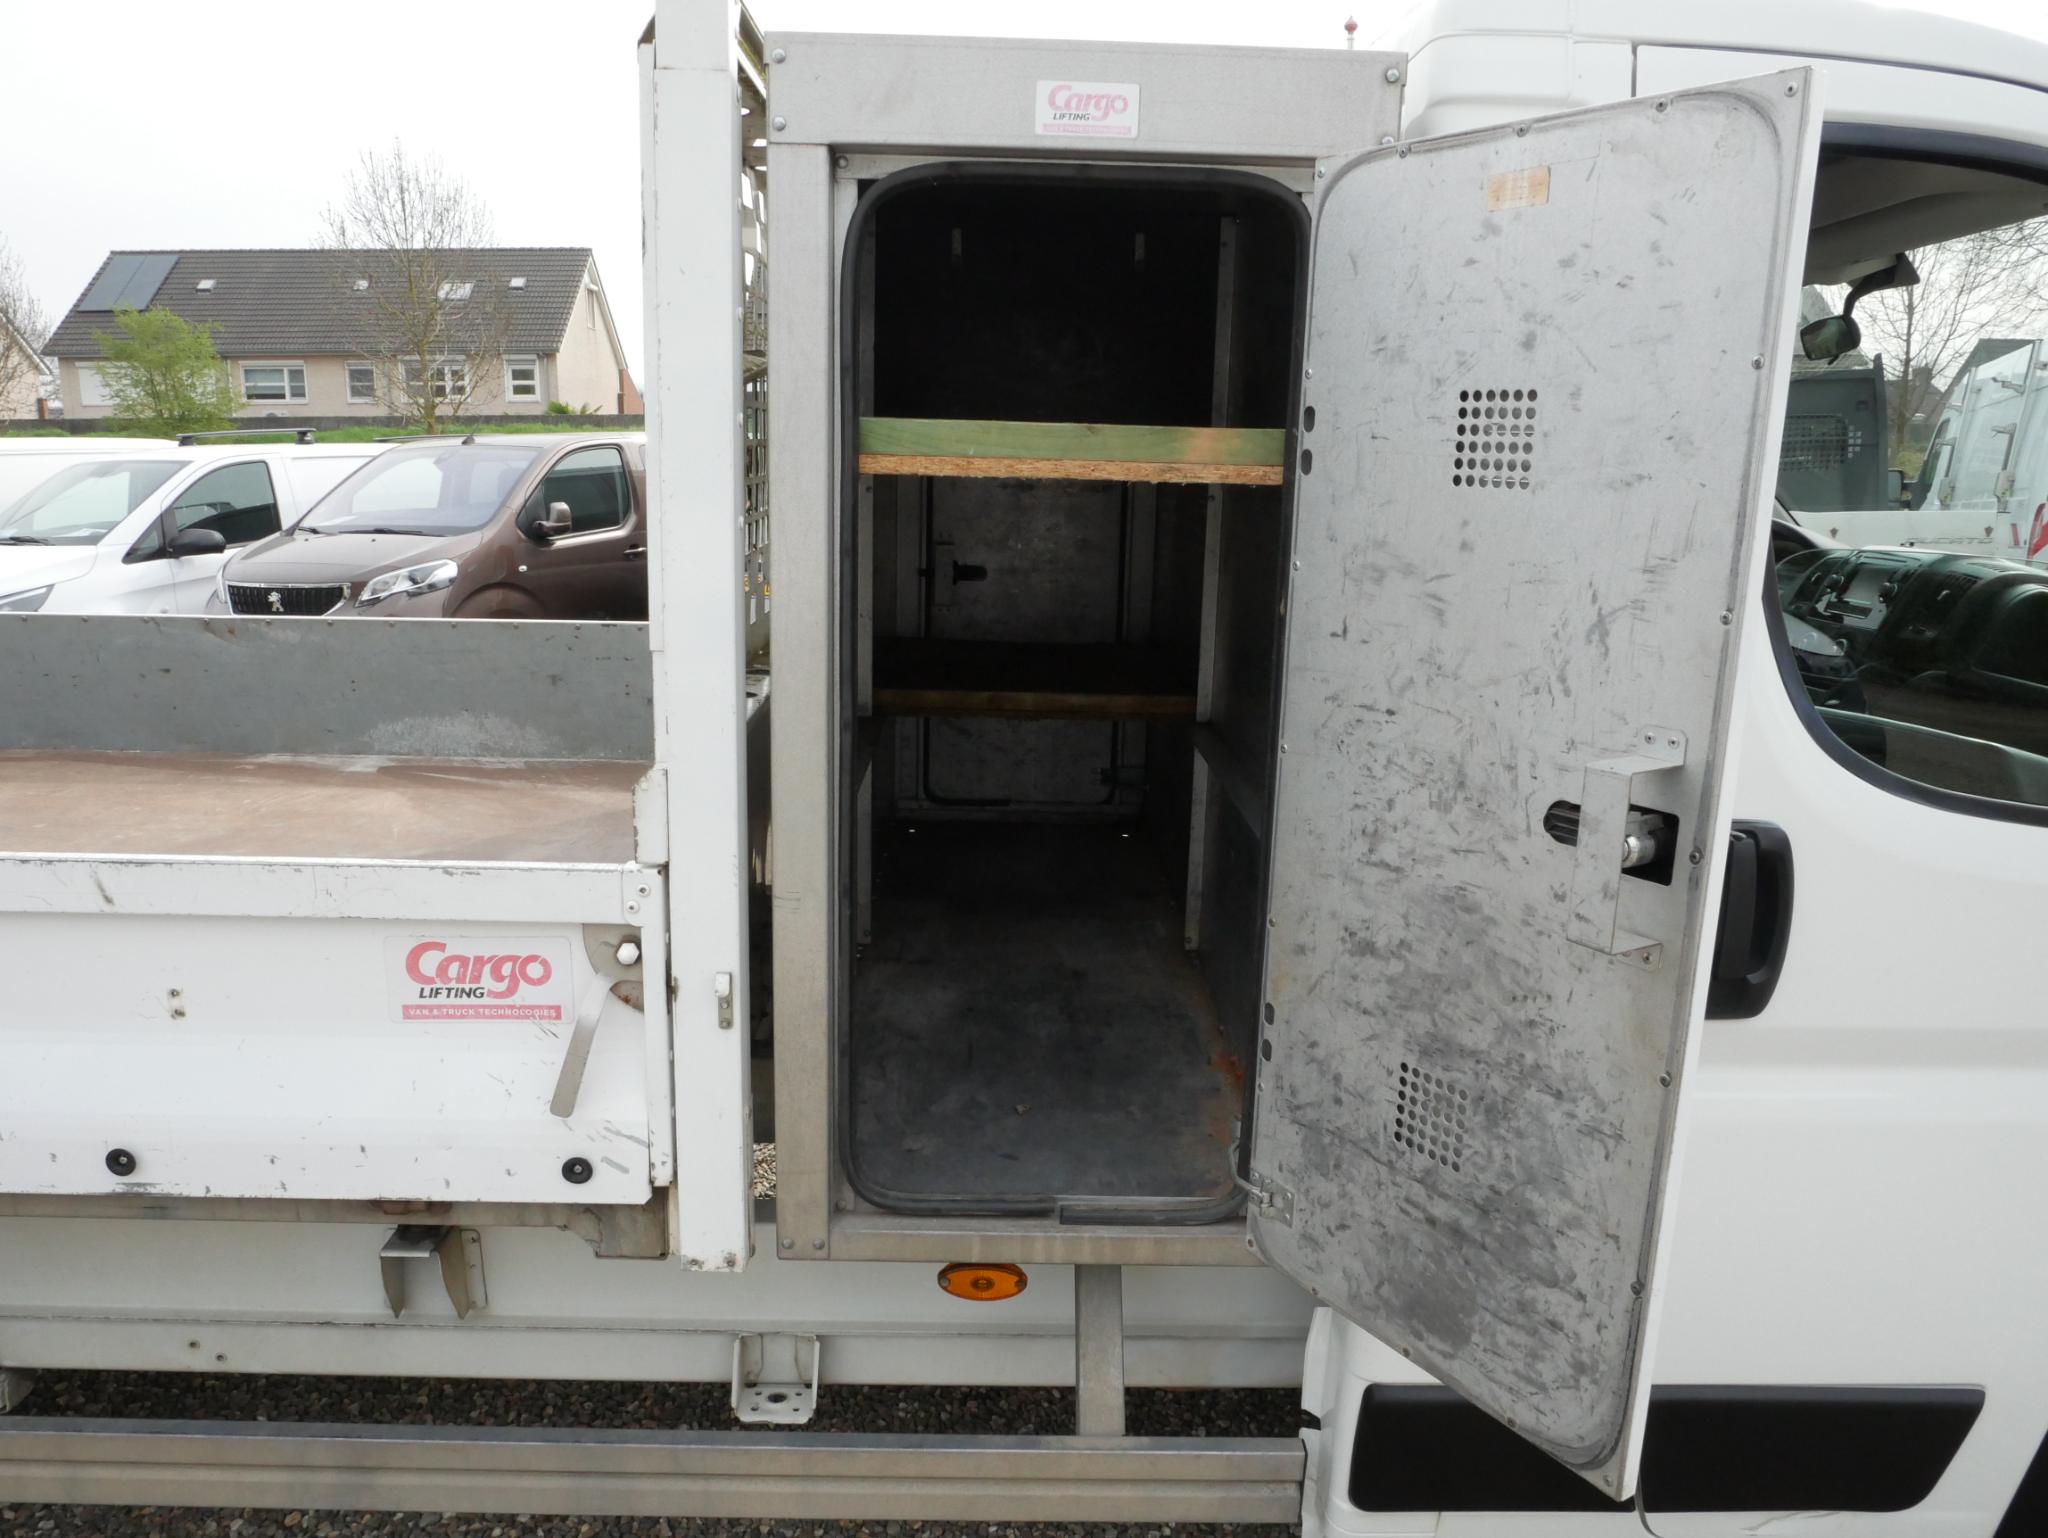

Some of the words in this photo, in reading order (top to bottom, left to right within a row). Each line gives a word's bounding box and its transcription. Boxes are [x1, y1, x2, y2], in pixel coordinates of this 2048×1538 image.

[1048, 84, 1129, 121] Cargo
[1053, 113, 1090, 121] LIFTING
[405, 941, 553, 999] Cargo
[418, 987, 485, 999] LIFTING
[408, 1008, 430, 1016] VAN
[442, 1008, 475, 1016] TRUCK
[478, 1008, 557, 1017] TECHNOLOGIES
